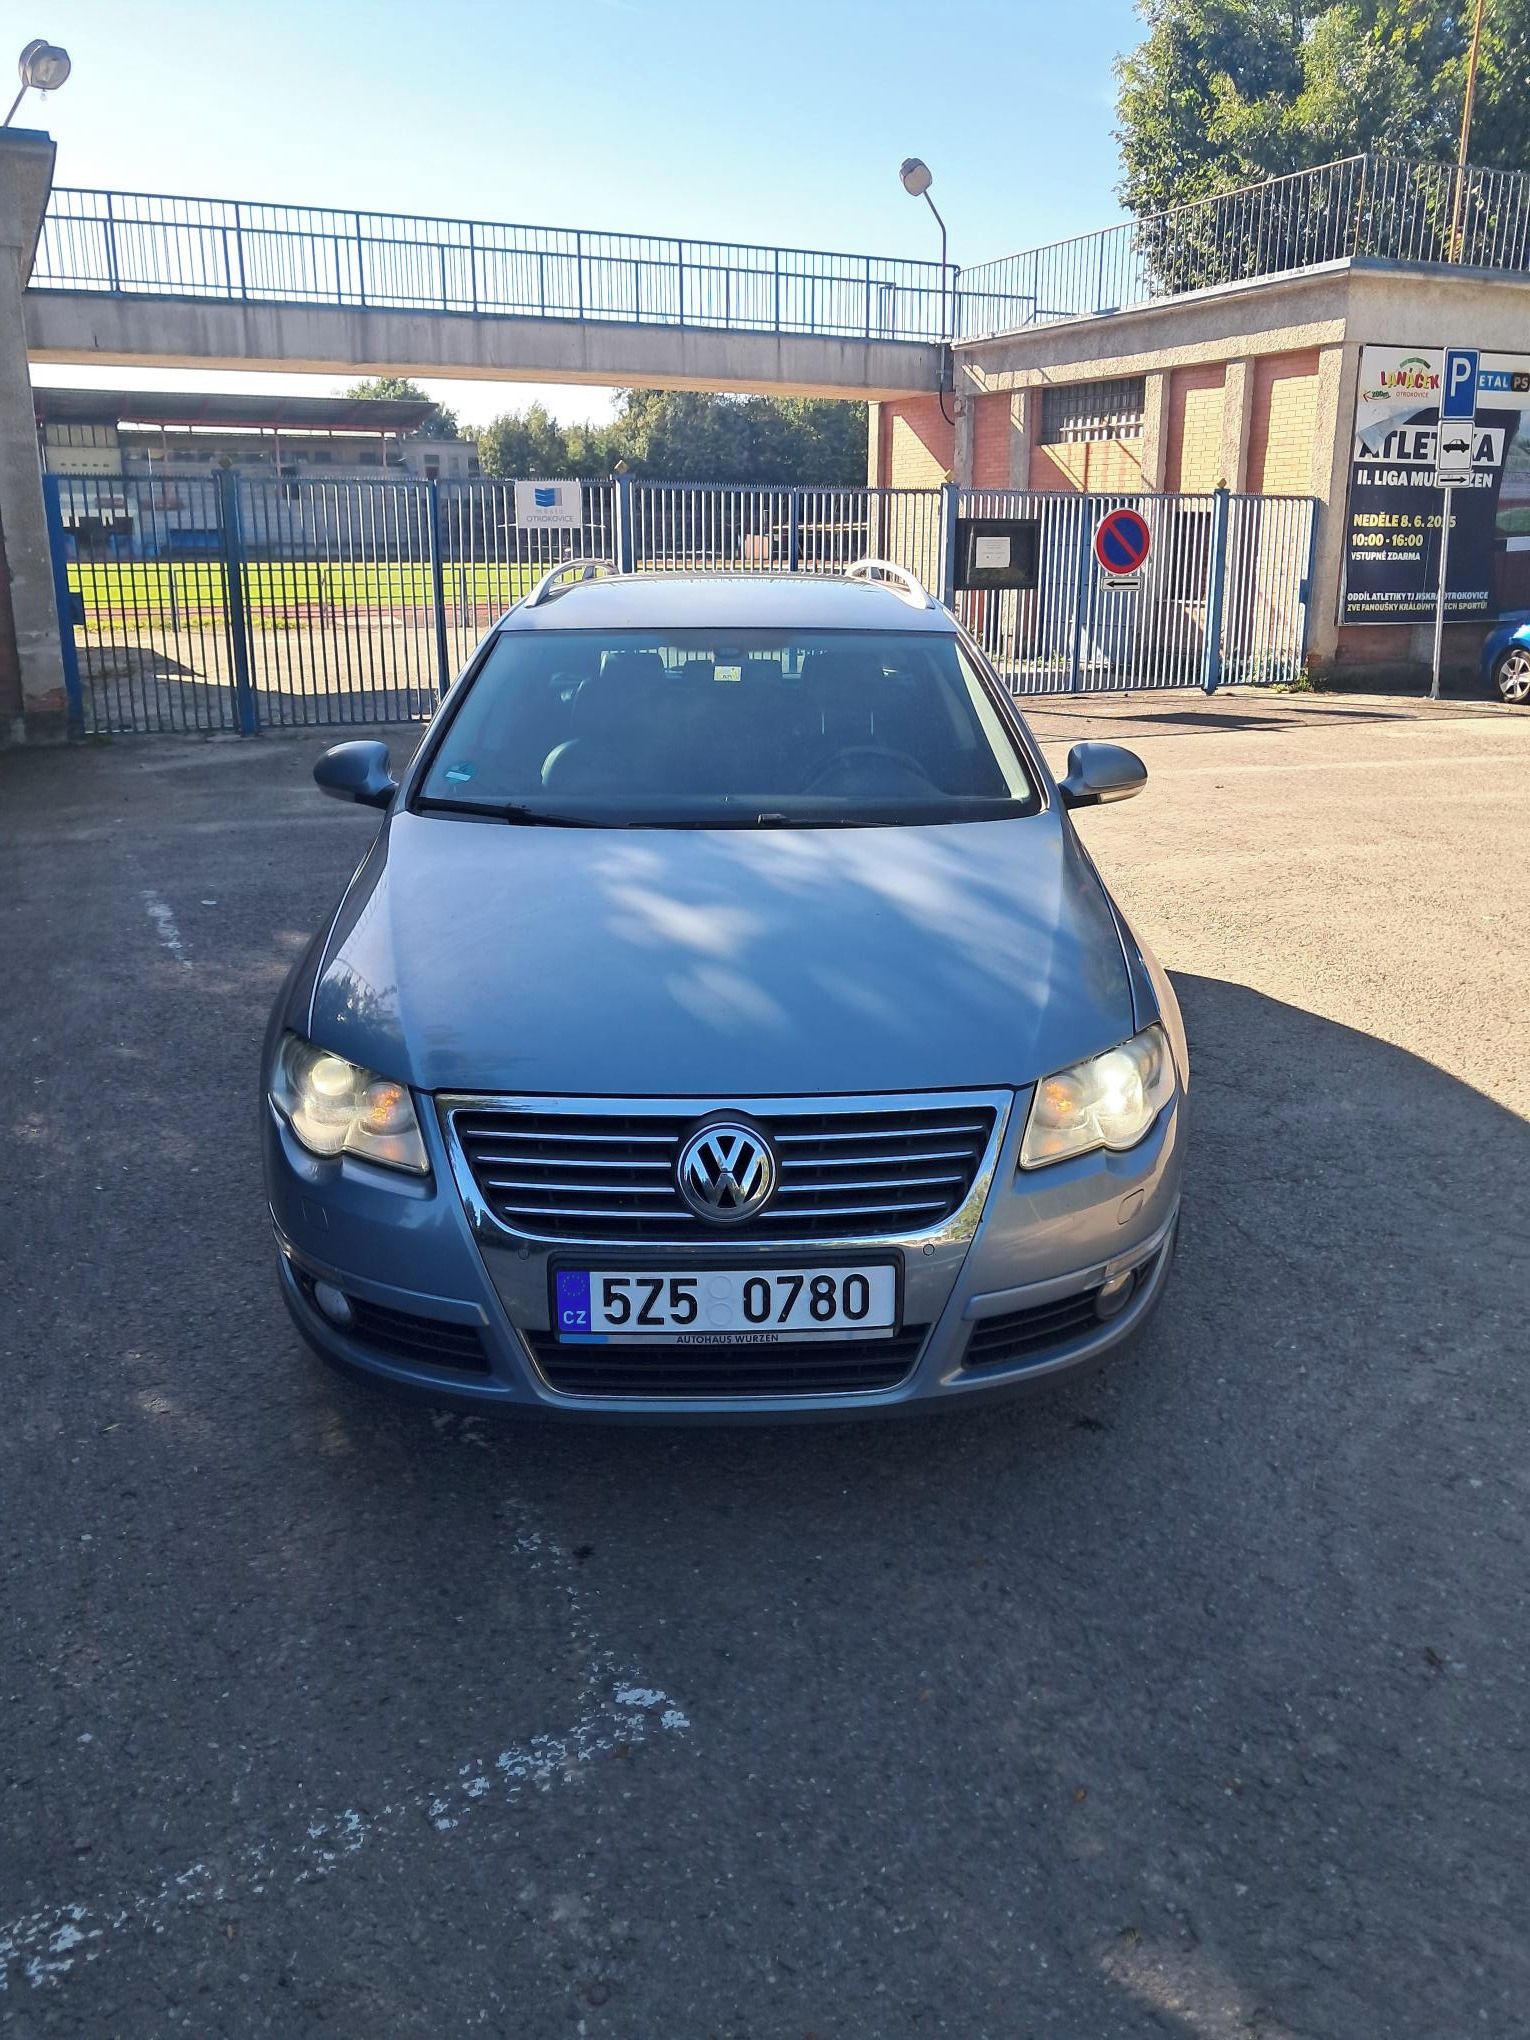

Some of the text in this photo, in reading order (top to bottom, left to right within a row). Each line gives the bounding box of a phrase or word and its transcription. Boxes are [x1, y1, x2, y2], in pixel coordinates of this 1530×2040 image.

[1450, 358, 1471, 397] P
[1479, 375, 1529, 389] ETAL PS
[1357, 469, 1371, 485] II.
[1374, 470, 1409, 486] LIGA
[1353, 511, 1457, 528] NEDĚLE 8. 6. 205
[1352, 533, 1384, 547] 10:00
[1391, 534, 1424, 547] 16:00
[1351, 550, 1421, 561] VSTUPNÉ ZDARMA
[1347, 591, 1371, 601] ODDÍL
[1371, 592, 1406, 601] ATLETIKY
[1415, 592, 1439, 601] JISKR
[1347, 603, 1361, 612] ZVE
[1361, 602, 1398, 611] FANOUŠKY
[1398, 602, 1435, 611] KRÁLOVNY
[562, 1273, 870, 1326] CZ 5Z5 0780
[676, 1334, 779, 1344] AUTOHAUS WURZEN
